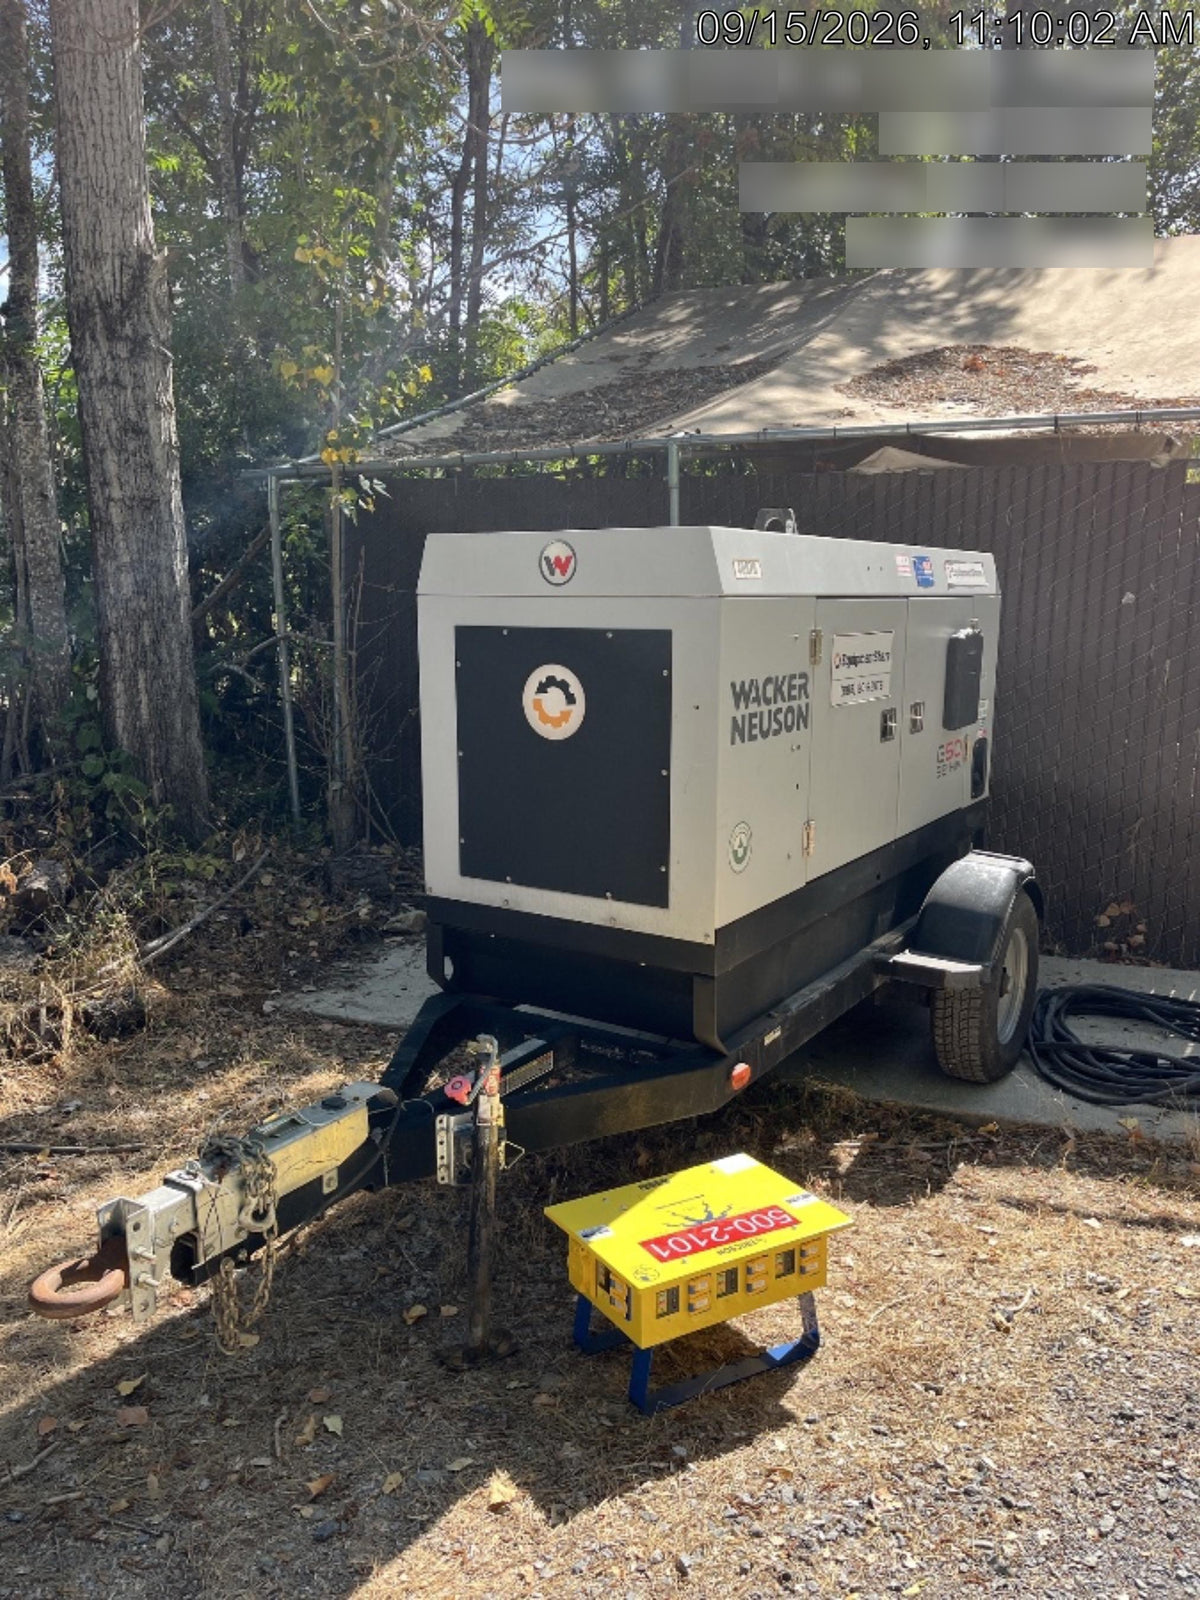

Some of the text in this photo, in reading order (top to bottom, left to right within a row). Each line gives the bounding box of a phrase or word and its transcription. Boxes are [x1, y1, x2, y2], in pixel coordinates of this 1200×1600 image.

[730, 671, 810, 711] WACKER
[730, 702, 810, 746] NEUSON
[648, 1207, 796, 1259] 500-2101
